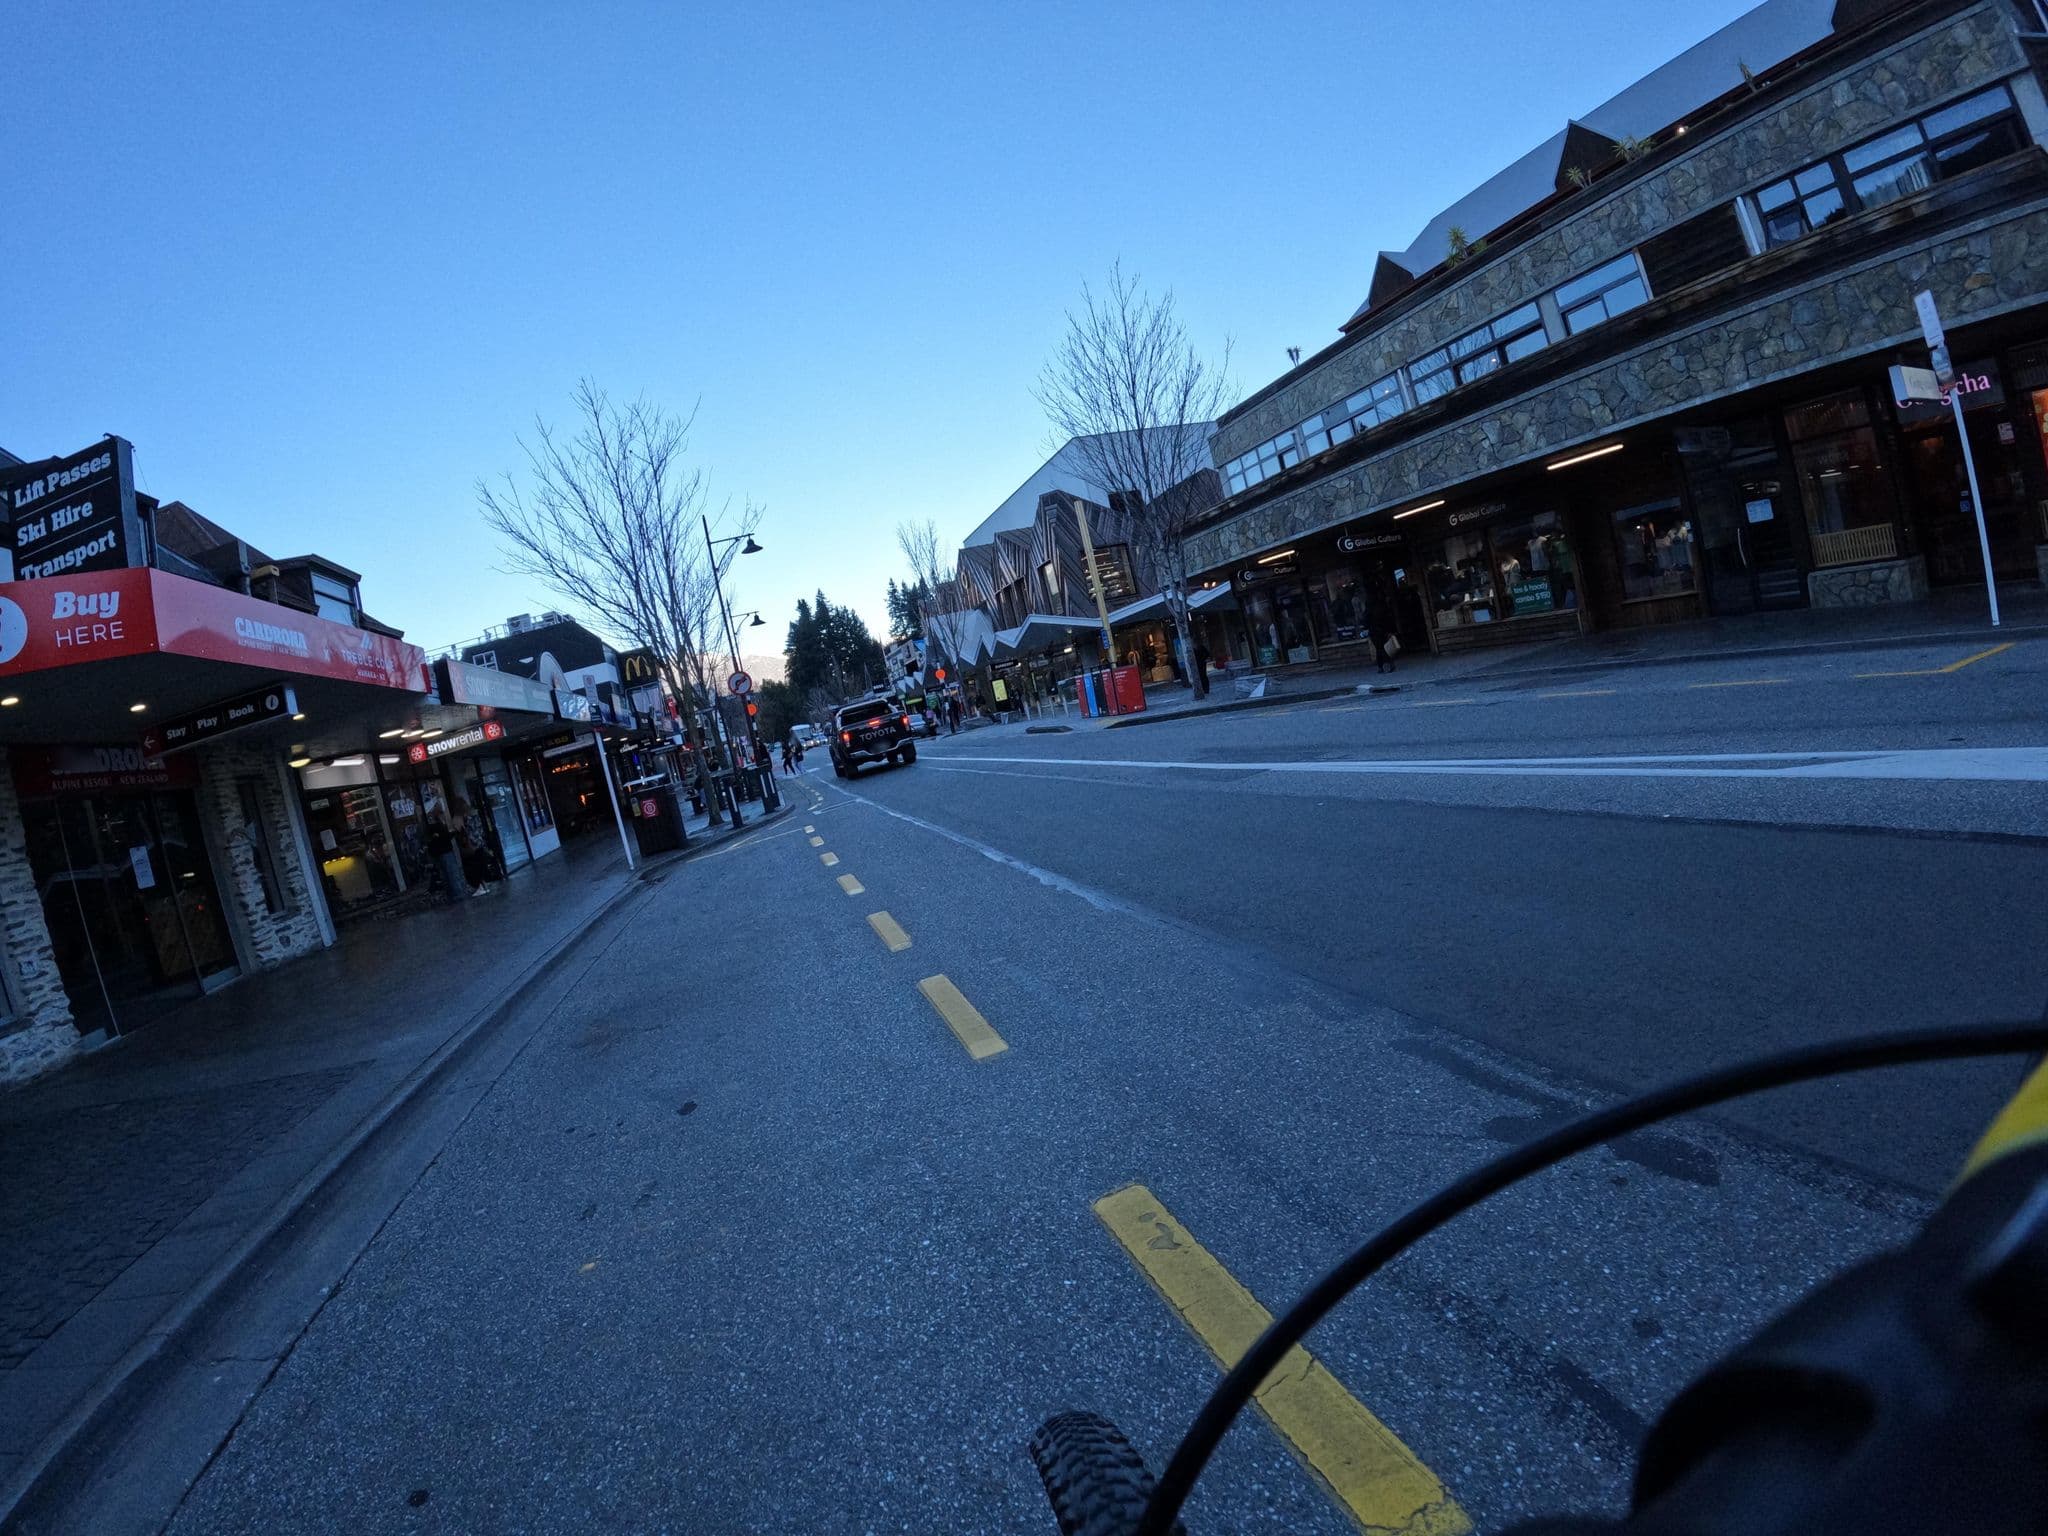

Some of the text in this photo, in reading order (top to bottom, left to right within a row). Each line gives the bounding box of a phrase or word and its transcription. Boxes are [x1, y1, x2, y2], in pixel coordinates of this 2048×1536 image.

[14, 452, 112, 508] Lift Passes
[17, 501, 93, 547] Ski Hire
[20, 529, 117, 580] Transport
[1355, 538, 1377, 547] Global
[1378, 534, 1402, 543] Culture
[52, 590, 120, 619] Buy
[56, 621, 125, 647] HERE
[235, 616, 307, 650] CARDRONA
[341, 649, 374, 668] TREBLE
[166, 704, 254, 740] Stay Play Book
[858, 727, 896, 742] TOYOTA
[427, 726, 484, 755] snowrental
